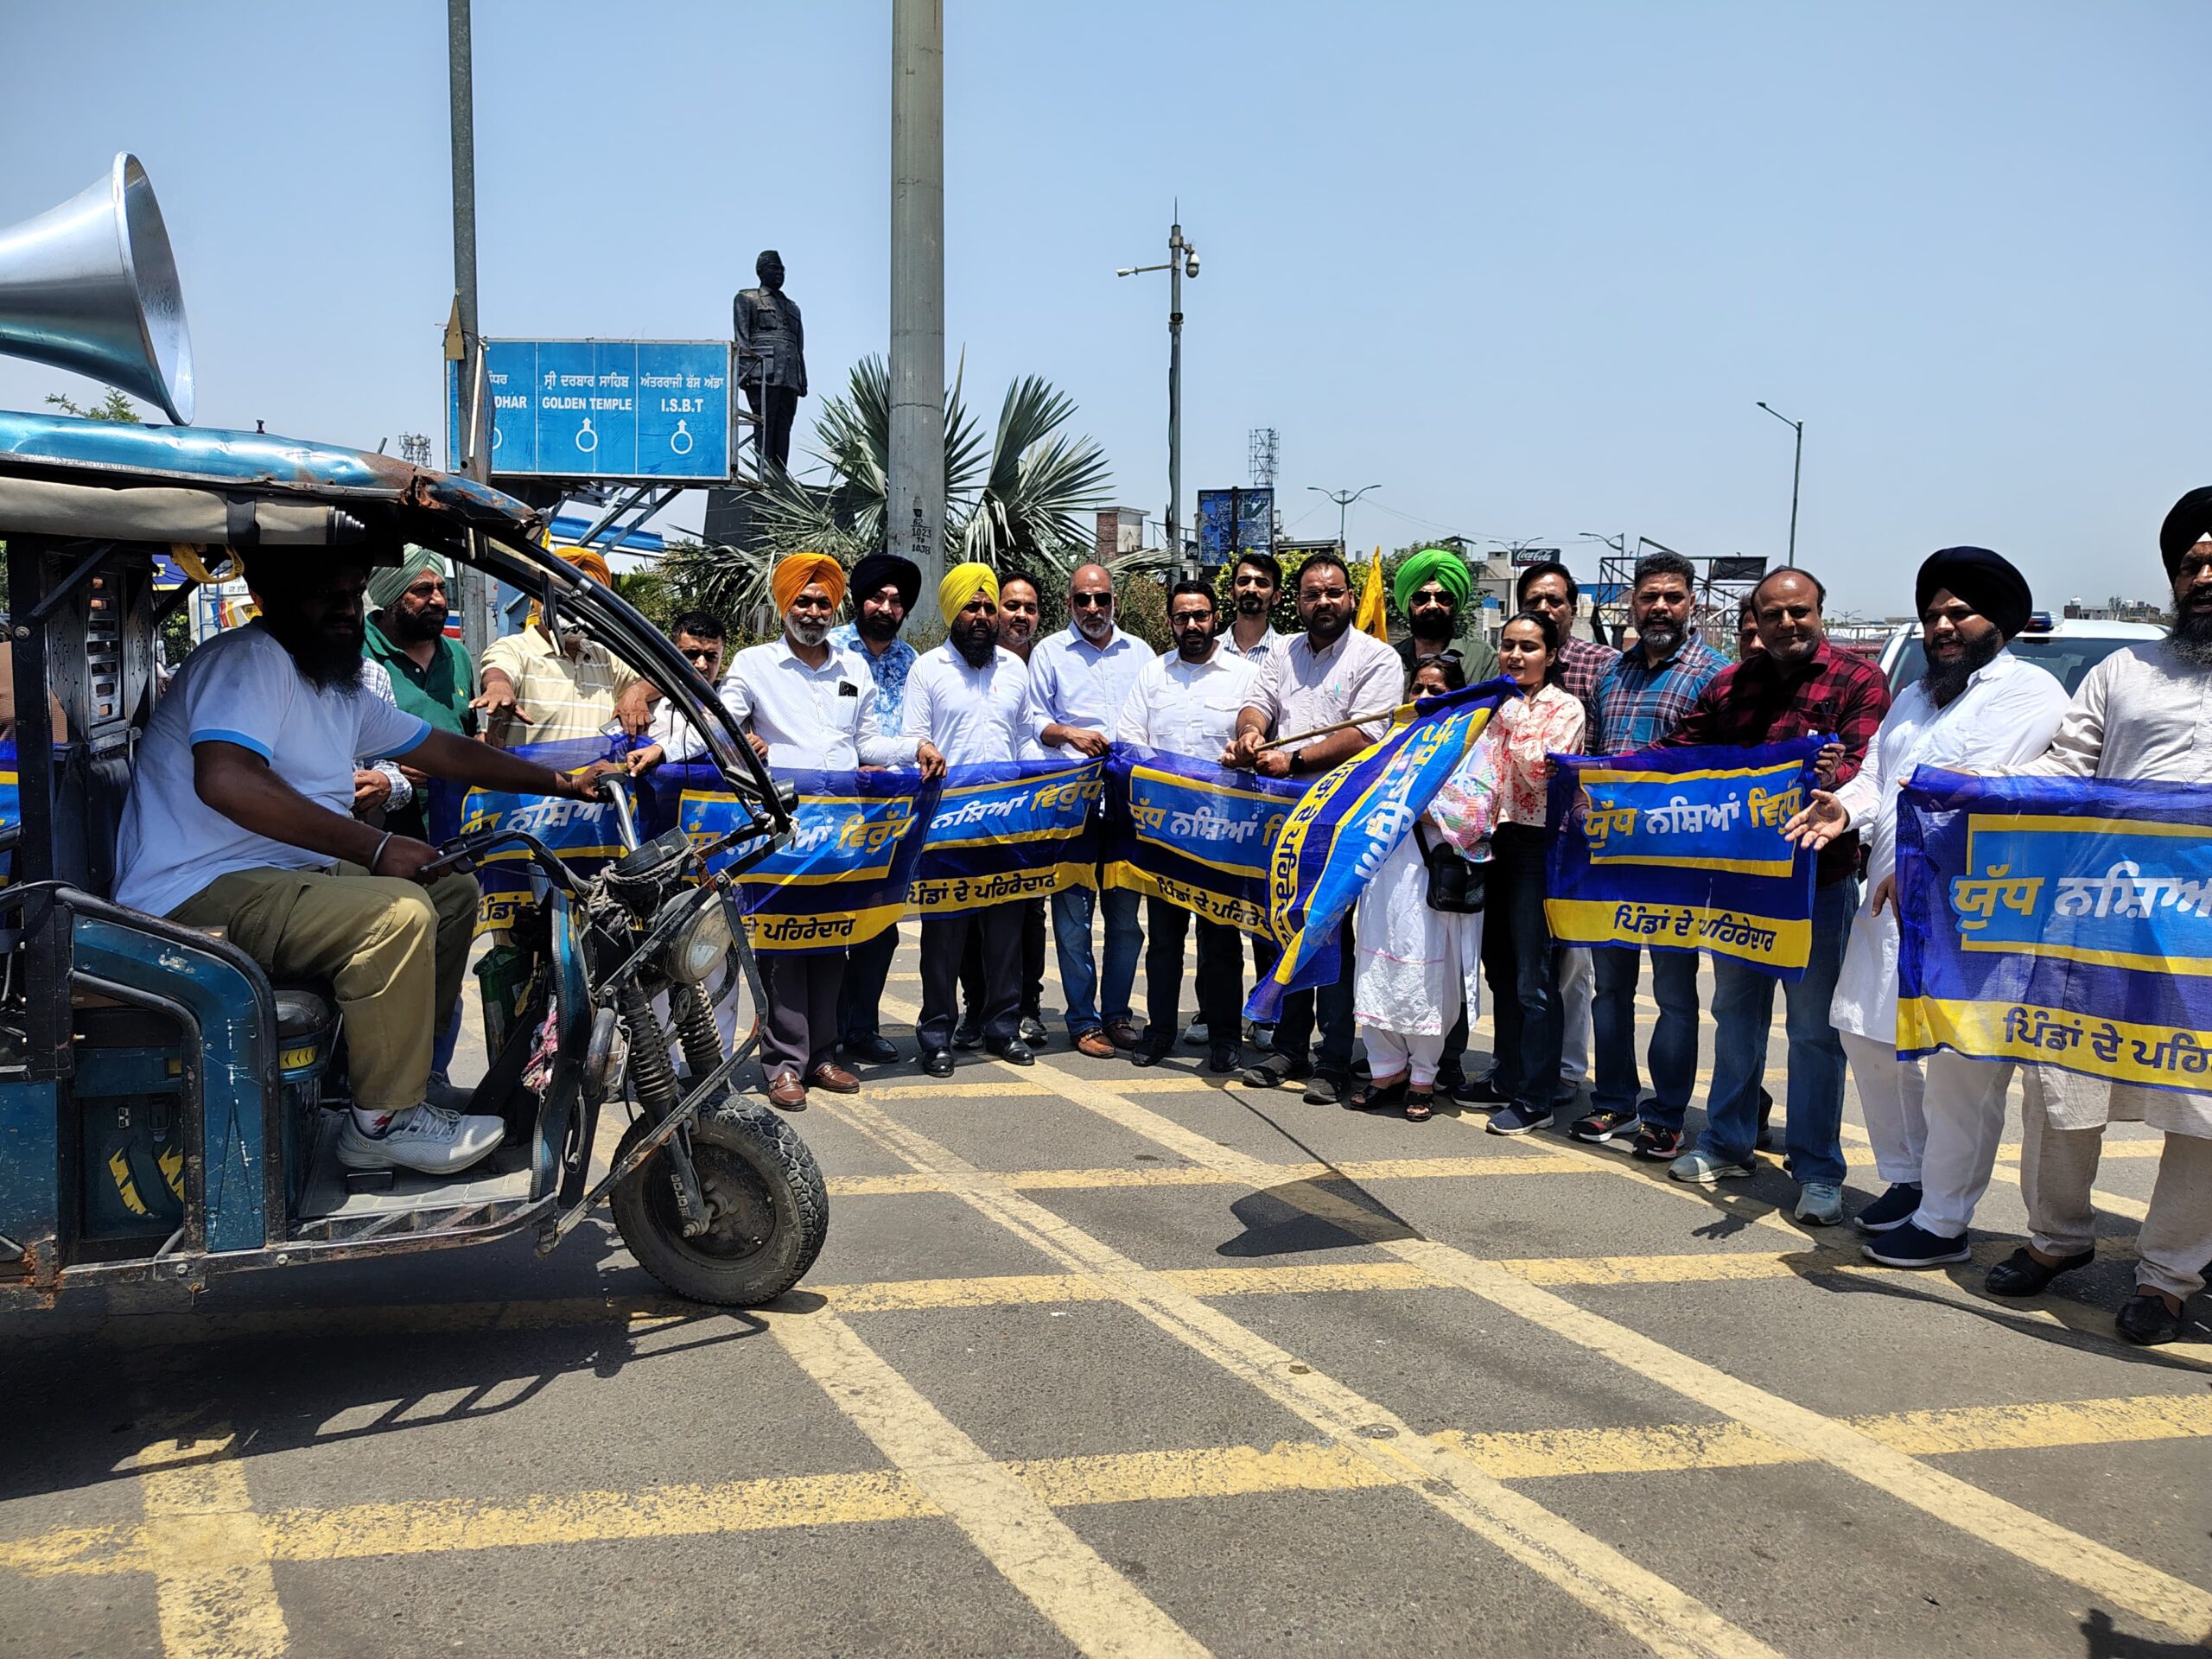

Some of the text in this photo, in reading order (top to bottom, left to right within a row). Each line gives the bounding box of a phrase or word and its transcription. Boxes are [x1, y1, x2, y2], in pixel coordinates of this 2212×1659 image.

[561, 374, 595, 387] ਦਰਬਾਰ
[599, 372, 629, 388] ਸਾਹਿਬ
[704, 374, 724, 389] ਅੱਡਾ
[542, 397, 632, 410] GOLDEN TEMPLE
[661, 398, 703, 412] I.S.B.T
[912, 528, 931, 538] 1023
[912, 544, 931, 555] 1038
[930, 772, 1103, 830] ਨਸ਼ਿਆਂ ਵਿਰੁੱਧ
[1294, 804, 1318, 823] ਦੇ
[836, 810, 917, 854] ਵਿਰੁੱਧ
[1170, 806, 1258, 843] ਨਸ਼ਿਆਂ
[1584, 800, 1637, 848] ਯੁੱਧ
[1644, 793, 1740, 835] ਨਸ਼ਿਆਂ
[953, 880, 970, 902] ਦੇ
[974, 872, 1058, 899] ਪਹਿਰੇਦਾਰ
[1156, 877, 1191, 903] ਪਿੰਡਾਂ
[1193, 891, 1209, 912] ਦੇ
[1954, 864, 2045, 930] ਯੁੱਧ
[764, 917, 856, 941] ਪਹਿਰੇਦਾਰ
[1614, 905, 1777, 951] ਪਿੰਡਾਂ ਦੇ ਪਹਿਰੇਦਾਰ
[2003, 1007, 2084, 1051] ਪਿੰਡਾਂ
[2090, 1022, 2124, 1063] ਦੇ
